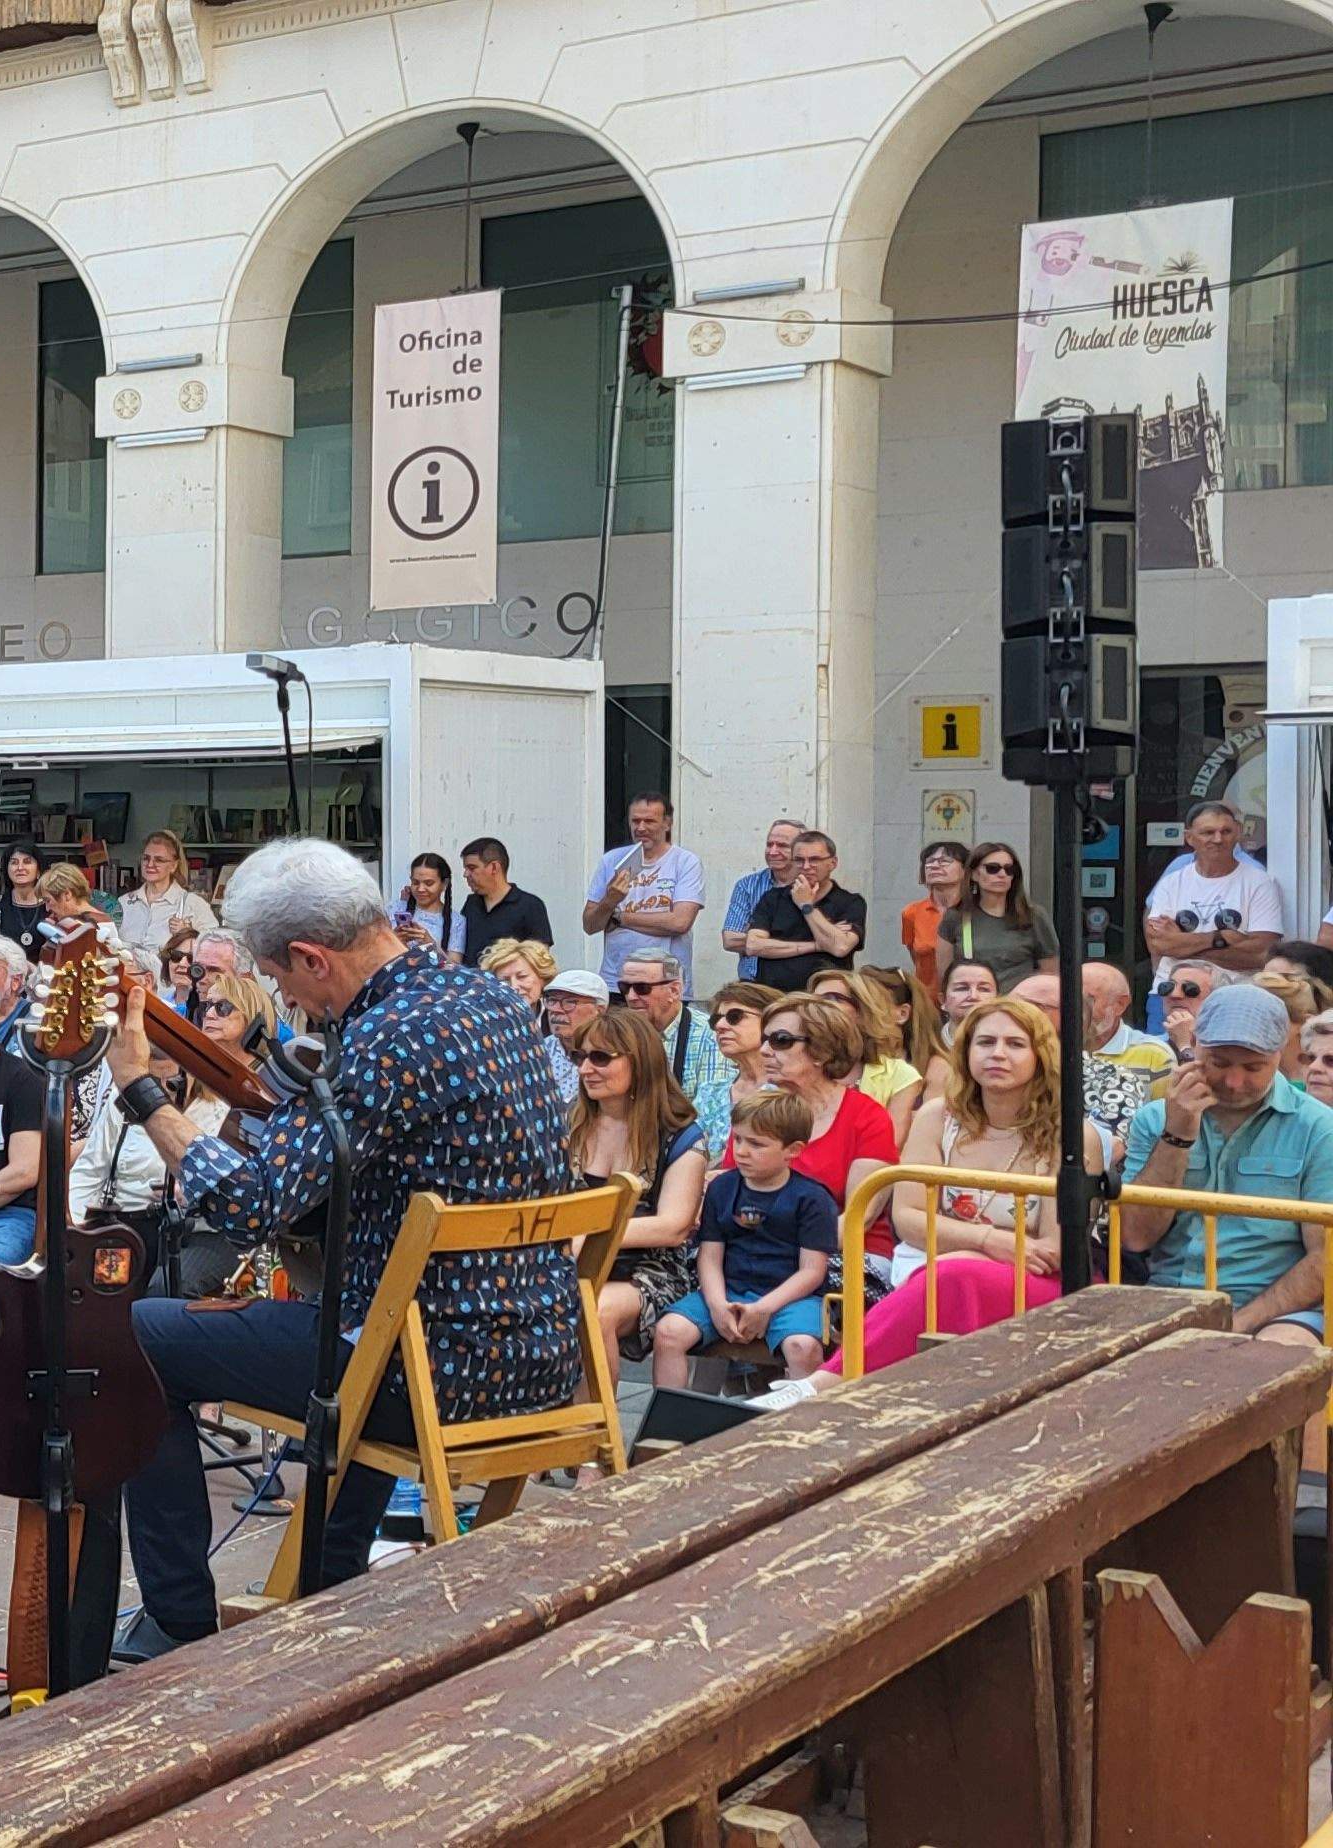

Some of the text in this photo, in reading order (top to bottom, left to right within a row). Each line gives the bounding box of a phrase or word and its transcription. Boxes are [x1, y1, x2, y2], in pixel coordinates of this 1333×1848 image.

[1112, 276, 1214, 320] HUESCA
[399, 327, 483, 353] Oficina
[1055, 317, 1217, 359] Ciudad de leyendas
[453, 353, 483, 375] de
[386, 385, 483, 410] Turismo
[1190, 722, 1265, 798] BIENVEN
